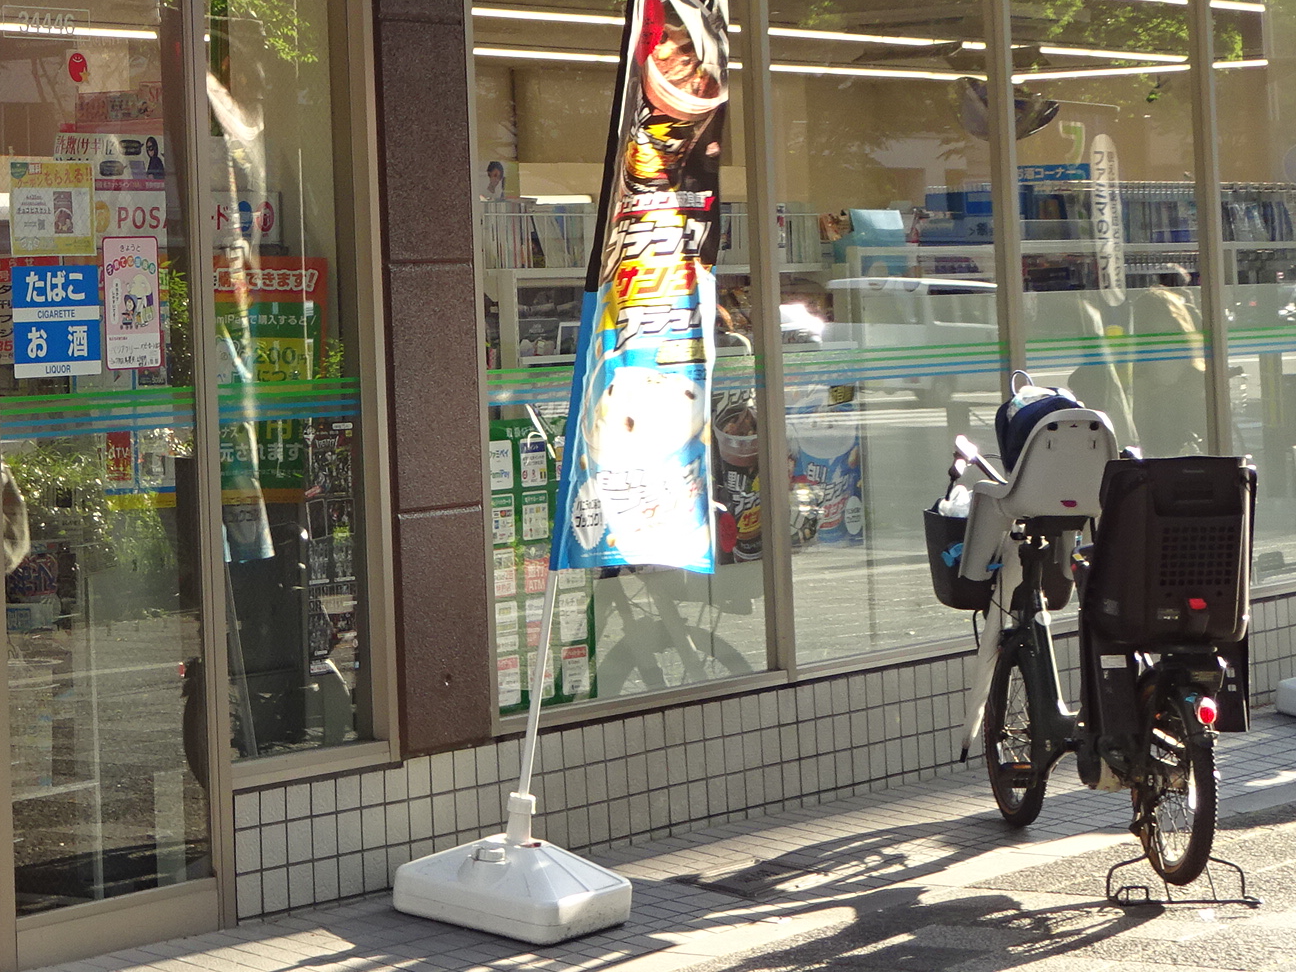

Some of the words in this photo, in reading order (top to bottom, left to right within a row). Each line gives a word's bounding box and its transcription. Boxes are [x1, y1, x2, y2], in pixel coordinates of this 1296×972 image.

[19, 10, 76, 35] 34446
[120, 244, 141, 253] きょうと
[25, 270, 86, 303] たばこ
[37, 309, 75, 319] CIGARETTE
[45, 365, 71, 374] LIQUOR
